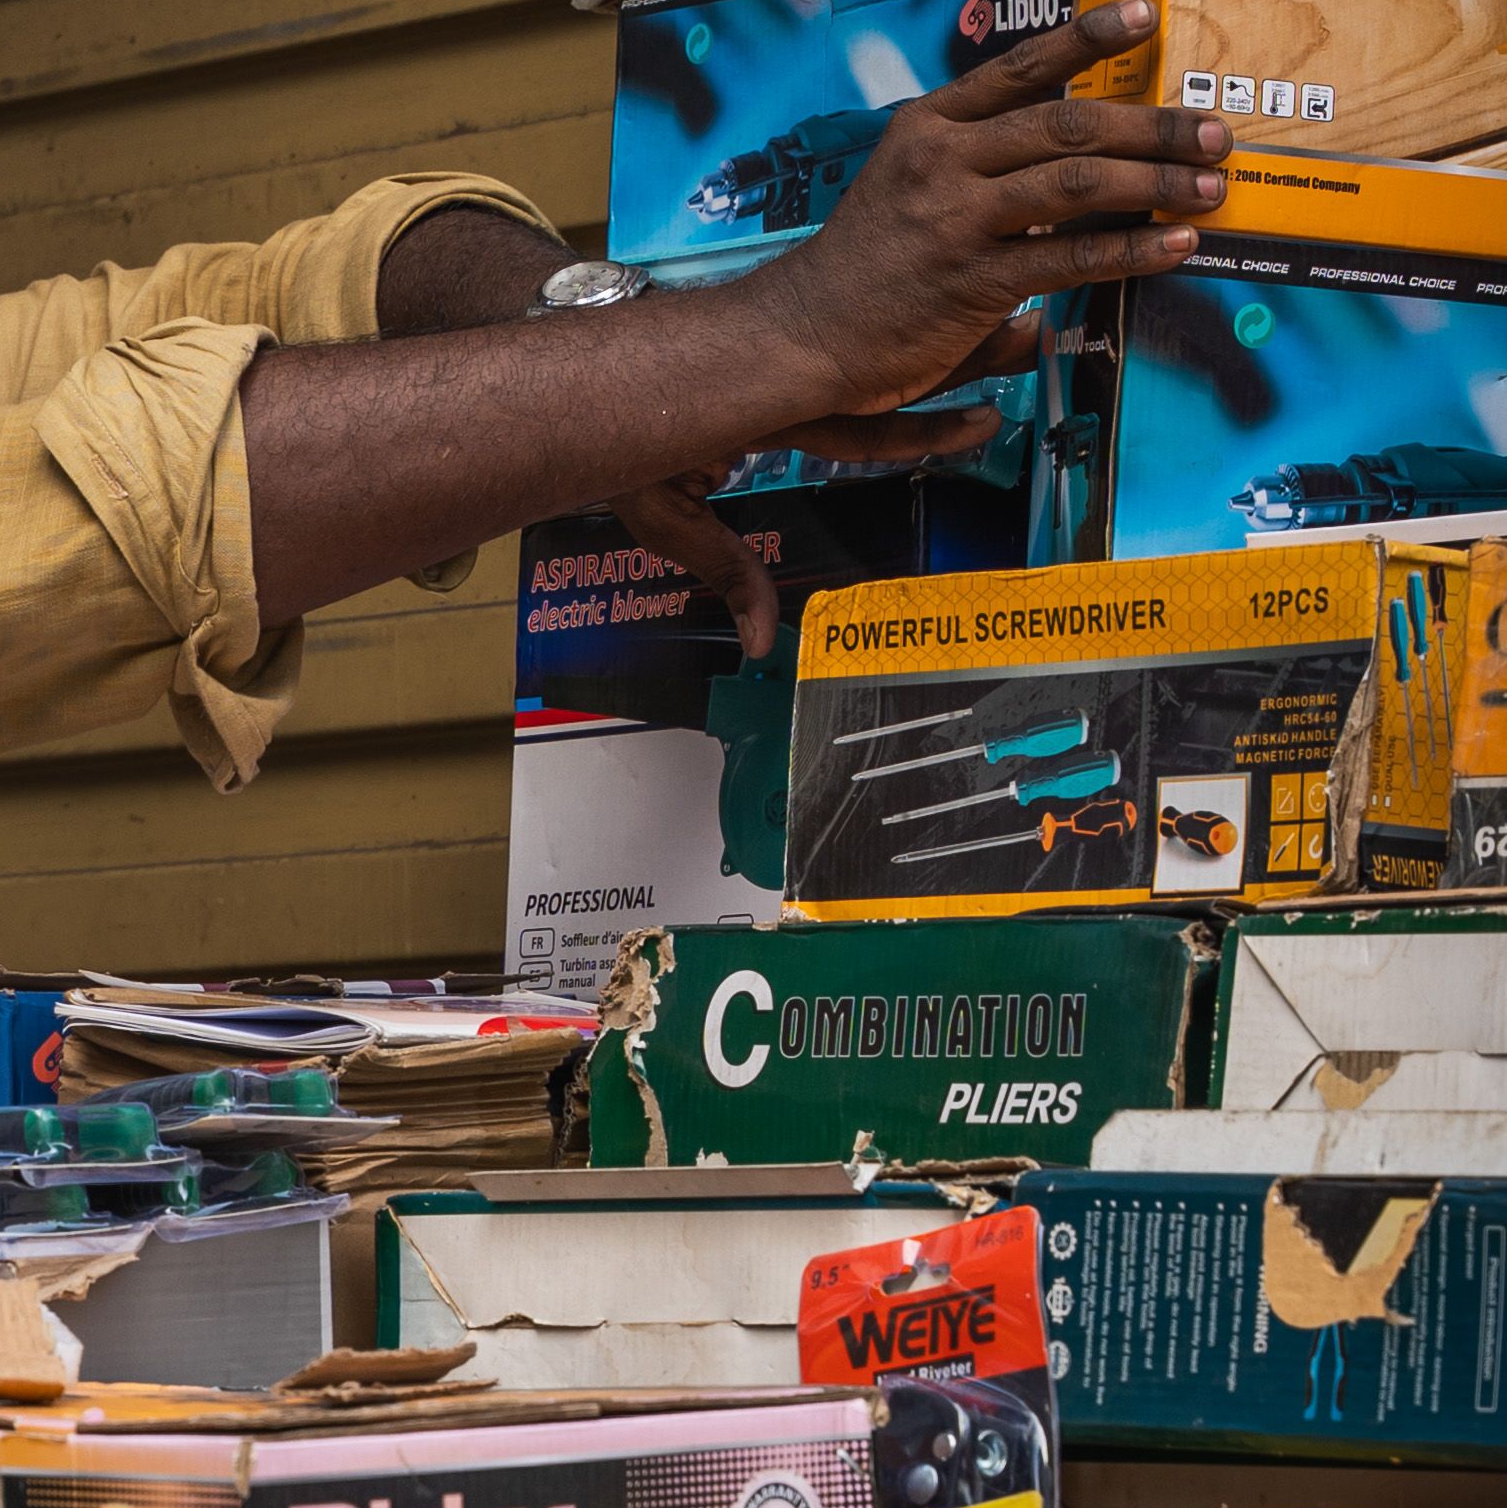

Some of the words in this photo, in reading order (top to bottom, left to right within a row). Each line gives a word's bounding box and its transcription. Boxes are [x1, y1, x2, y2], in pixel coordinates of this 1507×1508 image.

[1235, 169, 1262, 184] 2008
[1264, 172, 1310, 191] Certified
[1311, 177, 1361, 196] Company
[1241, 258, 1290, 275] CHOICE
[1309, 266, 1407, 286] PROFESSIONAL
[1408, 274, 1457, 291] CHOICE
[1055, 329, 1083, 356] LIDUO
[528, 594, 606, 632] electric
[610, 588, 691, 624] blower
[1250, 586, 1329, 619] 12PCS
[825, 615, 968, 653] POWERFUL
[974, 598, 1167, 643] SCREWDRIVER
[1259, 692, 1338, 711] ERGONORMIC
[1283, 711, 1338, 727] HRC54-60
[1292, 728, 1338, 744] HANDLE
[1235, 749, 1295, 765] MAGNETIC
[525, 885, 655, 917] PROFESSIONAL
[531, 936, 544, 950] FR
[561, 931, 599, 948] Soffleur
[560, 958, 597, 972] Turbina
[559, 974, 596, 989] manual
[700, 969, 1090, 1092] COMBINATION
[938, 1081, 1084, 1126] PLIERS
[837, 1284, 995, 1369] WEIYE
